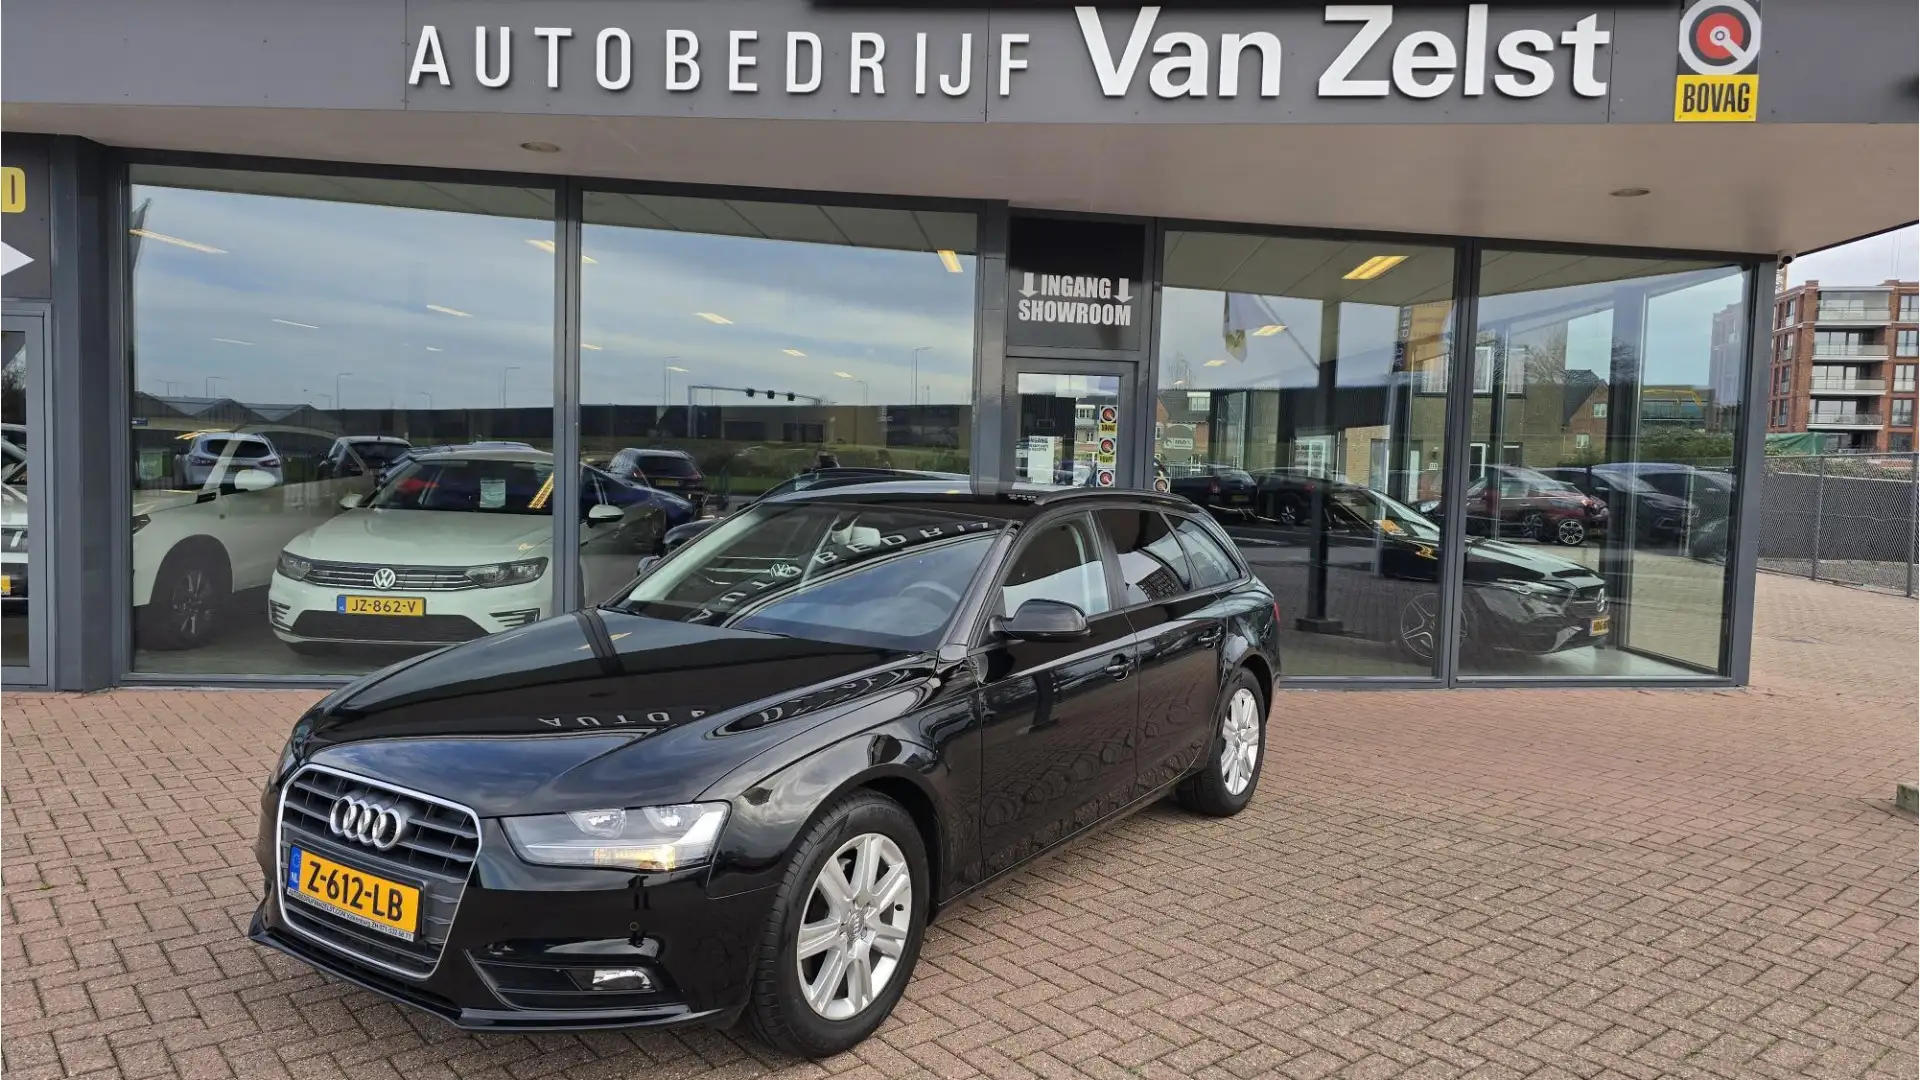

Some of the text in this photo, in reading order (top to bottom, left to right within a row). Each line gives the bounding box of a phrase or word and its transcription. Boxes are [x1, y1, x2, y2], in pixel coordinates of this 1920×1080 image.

[408, 4, 1611, 98] AUTOBEDRIJF Van Zelst
[1682, 83, 1751, 113] BOVAG
[1041, 274, 1111, 299] INGANG
[1018, 299, 1131, 326] SHOWROOM
[352, 599, 416, 613] JZ-862-V
[307, 860, 404, 922] Z-612-LB
